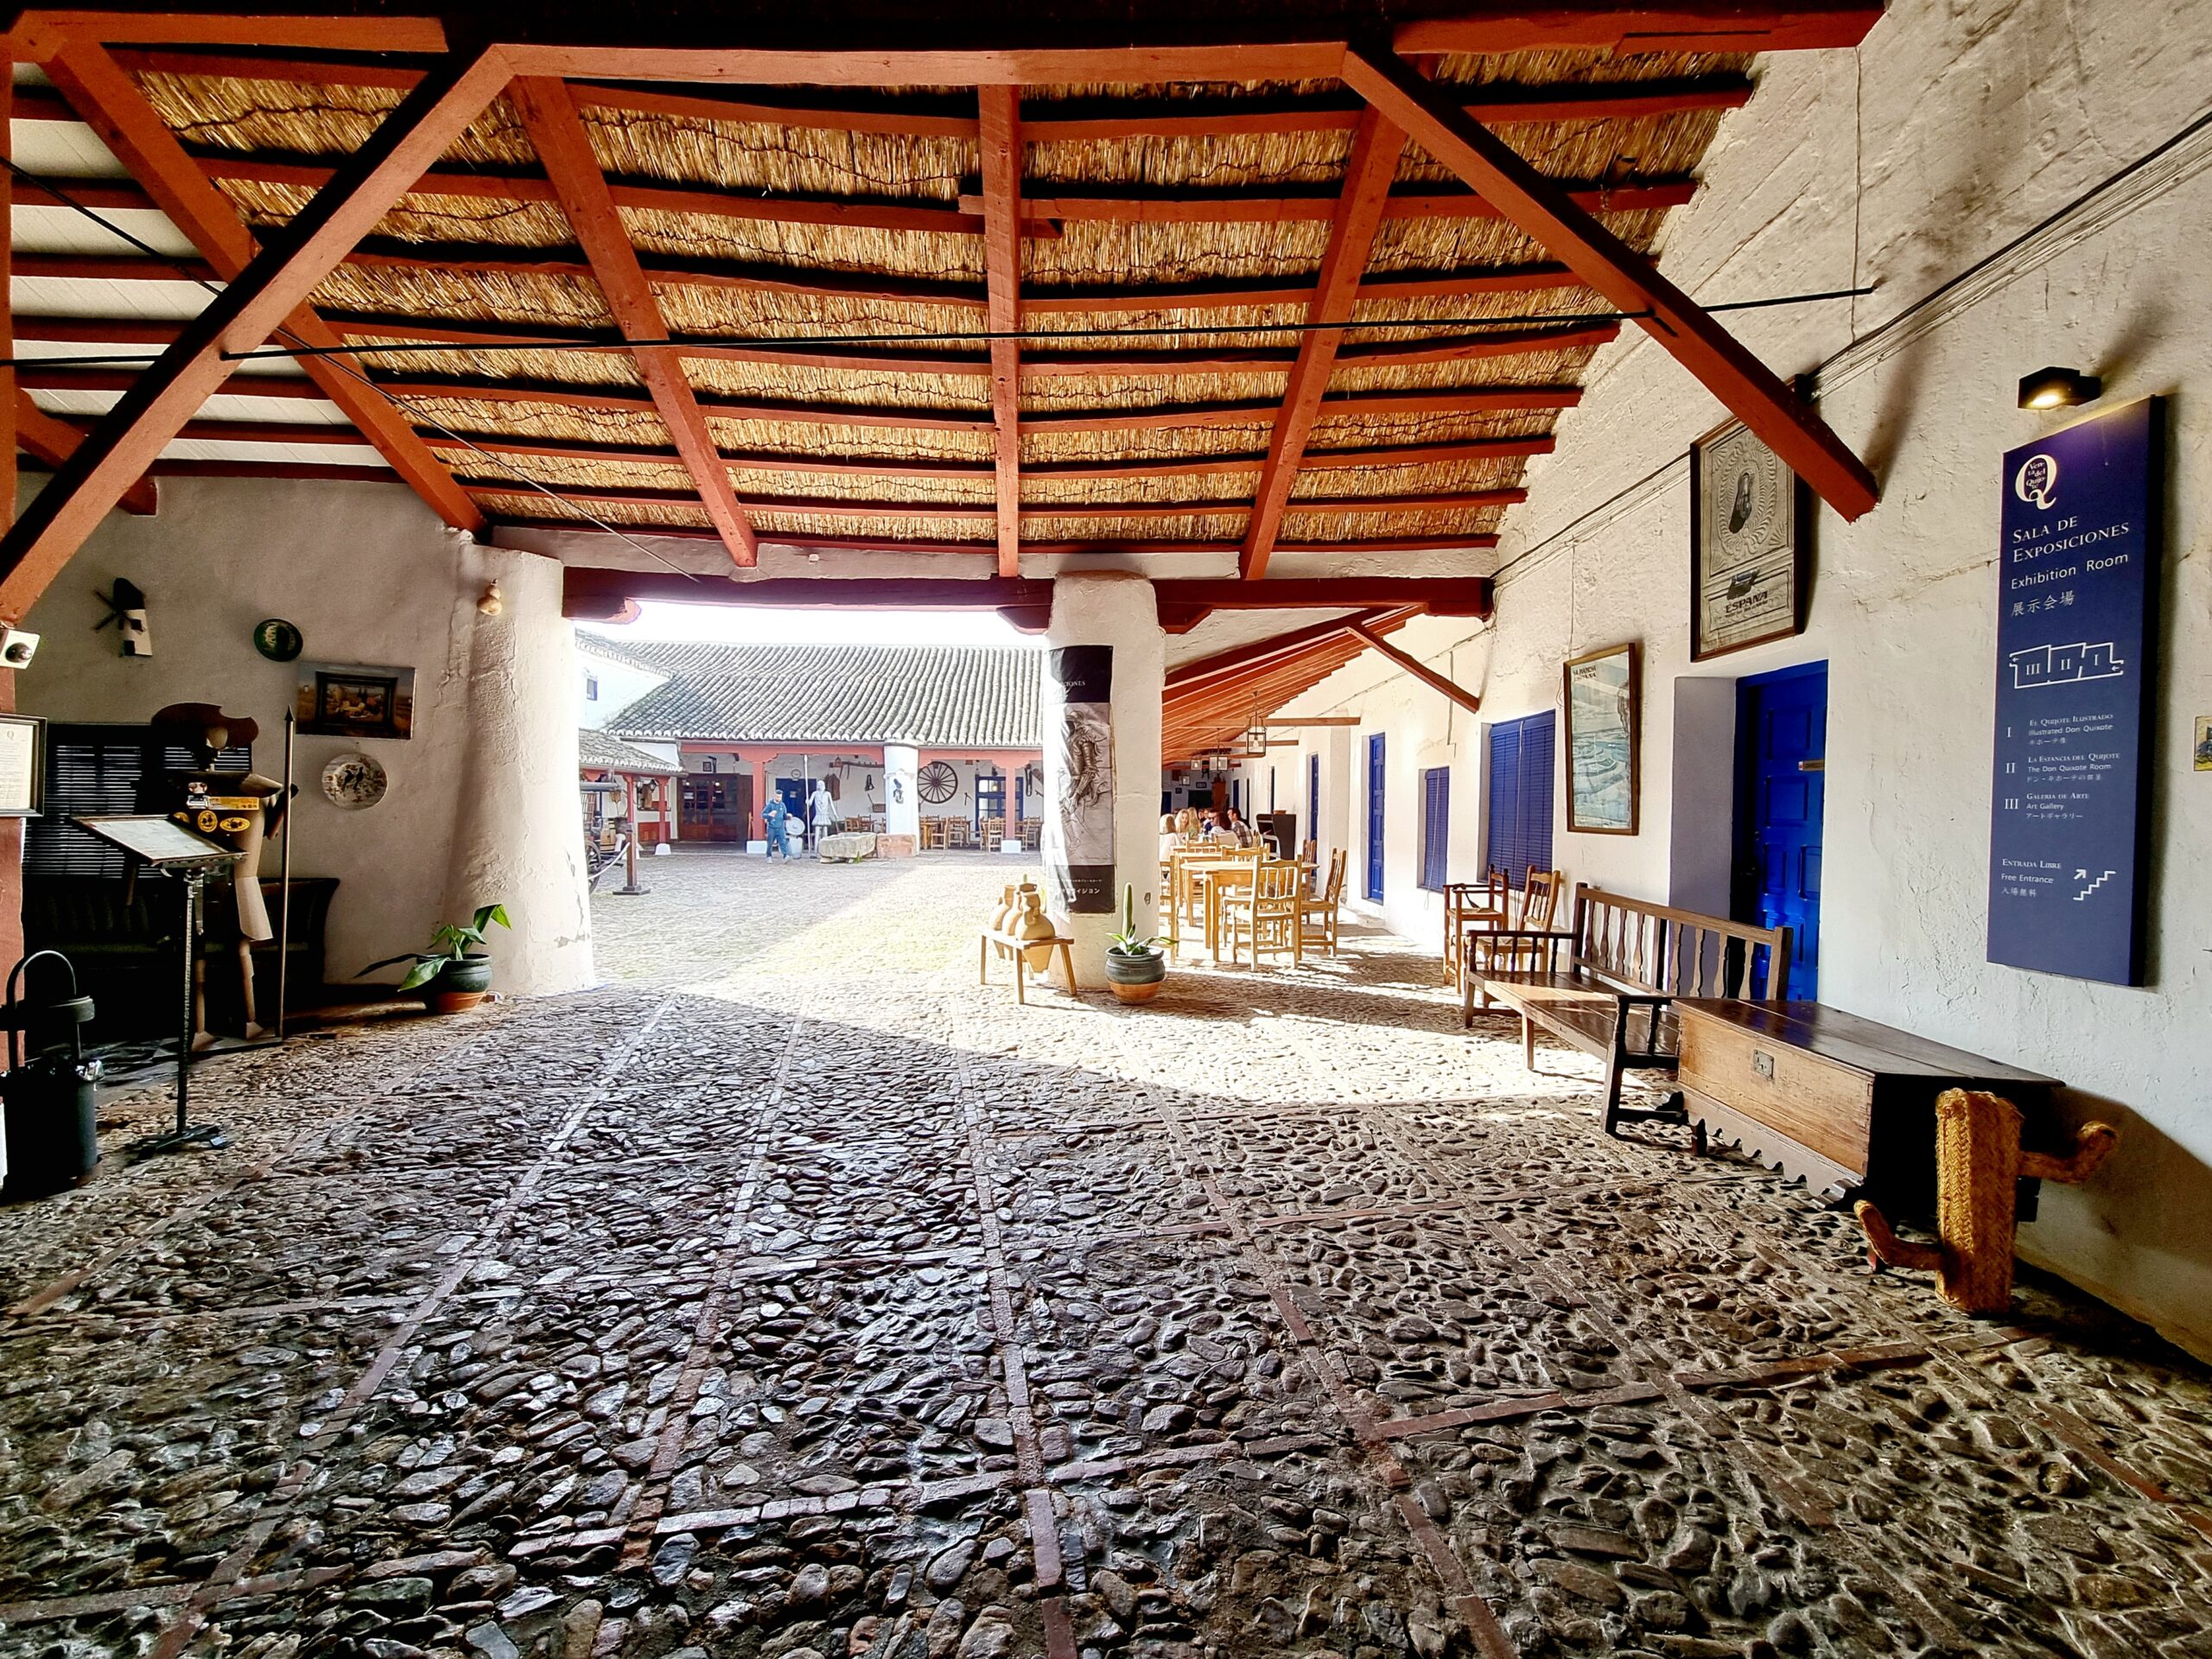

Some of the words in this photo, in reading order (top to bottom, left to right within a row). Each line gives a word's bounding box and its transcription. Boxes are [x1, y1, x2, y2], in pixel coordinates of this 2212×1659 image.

[2015, 454, 2056, 510] Q
[2012, 525, 2050, 543] SALA
[2057, 516, 2078, 531] DE
[2013, 523, 2130, 563] EXPOSICIONES
[2011, 566, 2076, 589] Exhibition
[2086, 554, 2128, 572] Room
[2012, 590, 2075, 617] 展示会場
[2026, 663, 2040, 676] III
[2061, 658, 2071, 671] II
[2006, 727, 2012, 738] I
[2028, 728, 2063, 736] Illustrated
[2005, 762, 2016, 774] II
[2005, 798, 2019, 810] III
[2002, 858, 2037, 868] ENTRADA
[2001, 873, 2017, 881] Free
[2018, 874, 2054, 884] Entrance
